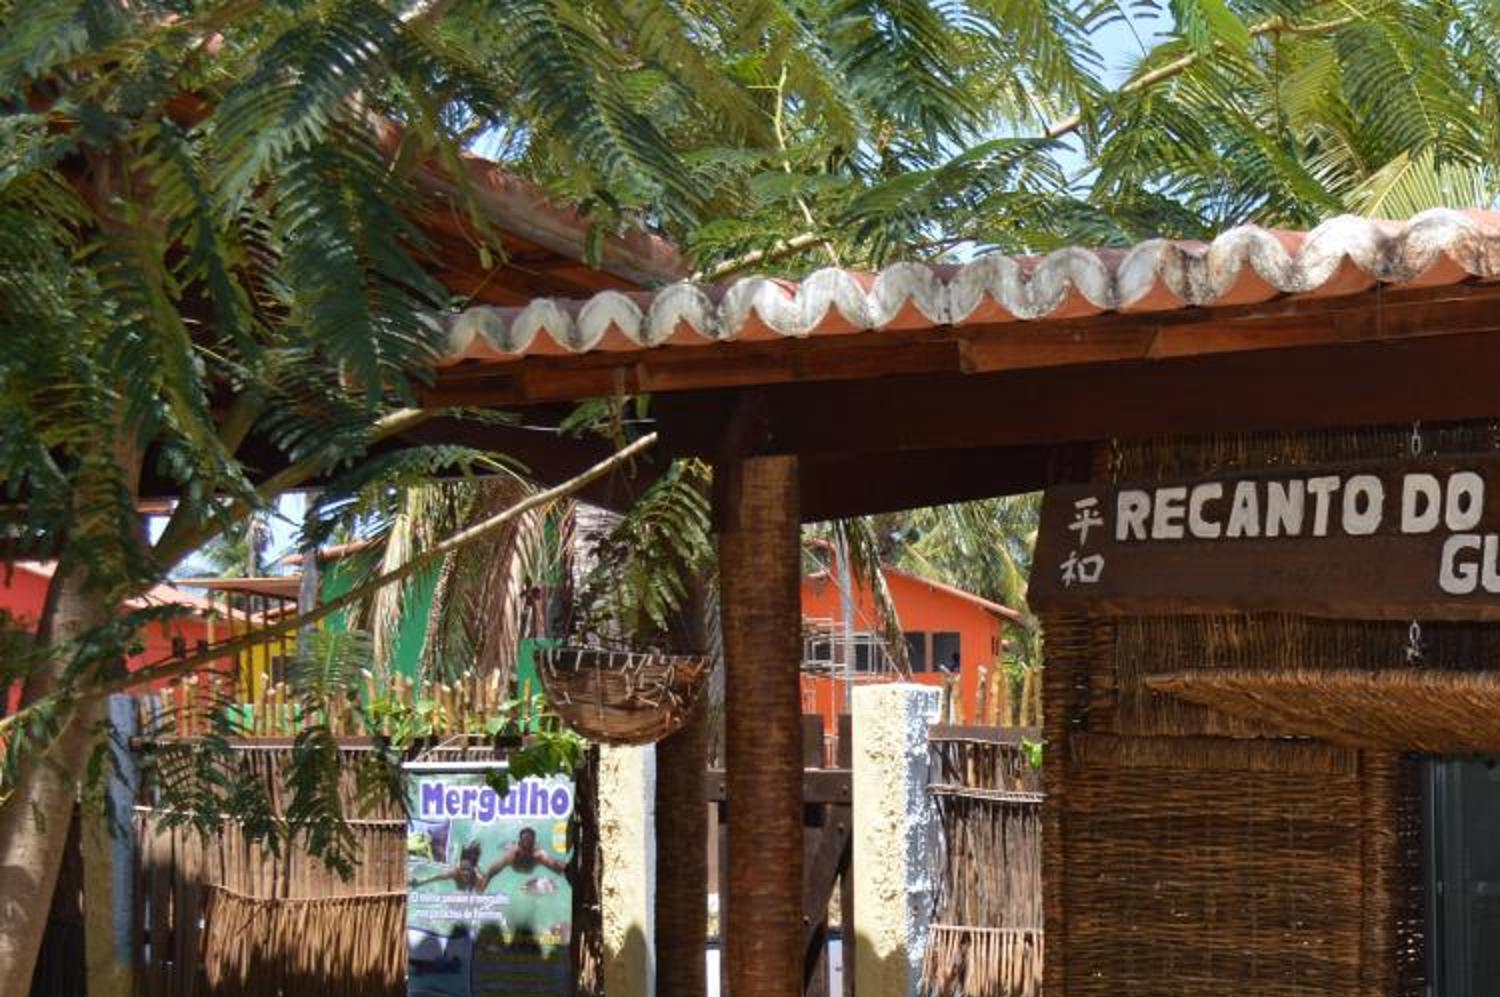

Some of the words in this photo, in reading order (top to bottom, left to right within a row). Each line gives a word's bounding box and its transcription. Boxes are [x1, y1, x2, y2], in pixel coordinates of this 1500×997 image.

[1115, 475, 1384, 541] RECANTO
[1401, 473, 1485, 532] DO
[1060, 497, 1104, 587] 平和
[420, 781, 571, 823] Mergulho
